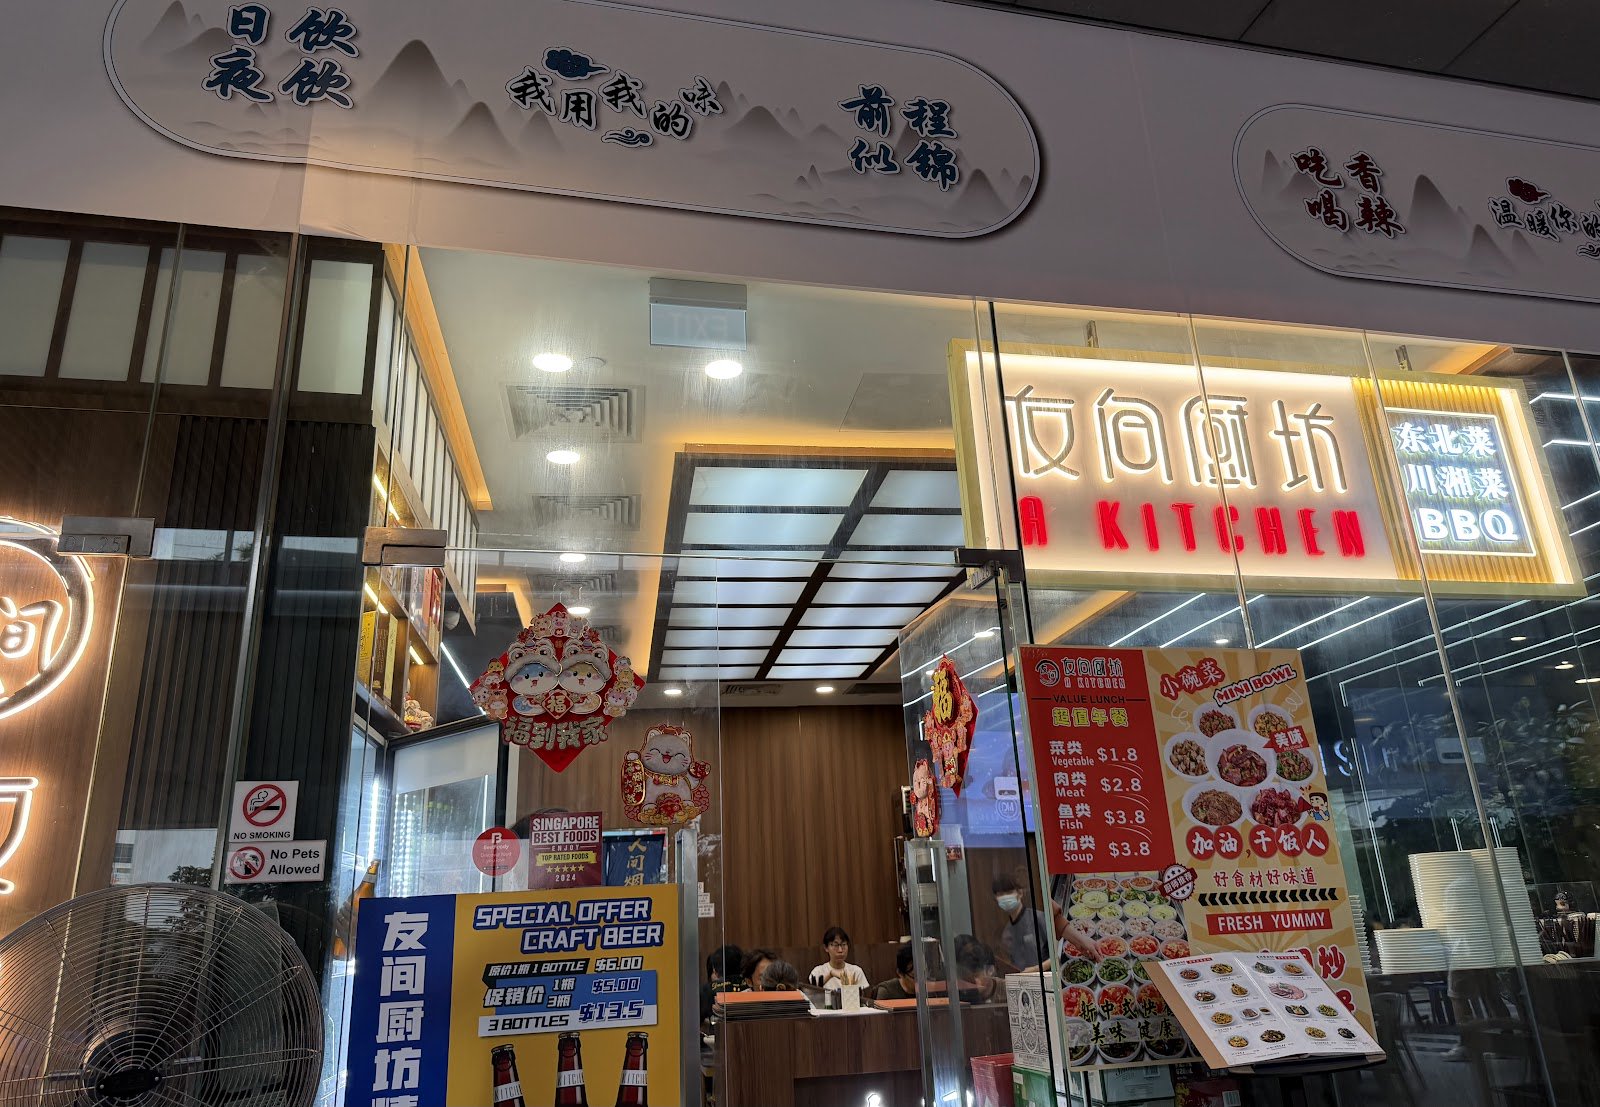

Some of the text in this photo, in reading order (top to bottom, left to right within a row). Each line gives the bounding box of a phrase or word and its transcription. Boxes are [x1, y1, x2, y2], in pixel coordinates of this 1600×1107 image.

[507, 68, 721, 139] 我用我的味
[1490, 198, 1600, 240] 温暖你的
[1394, 421, 1496, 457] 东北菜
[1404, 463, 1509, 500] 川湘菜
[1018, 495, 1367, 558] A KITCHEN
[1415, 507, 1519, 542] BBQ
[1077, 677, 1126, 689] KITCHEN
[1161, 660, 1224, 698] 小碗菜
[1214, 664, 1296, 706] MINI BOWL
[1052, 694, 1126, 704] VALUE LUNCH
[1052, 707, 1129, 727] 超值午餐
[1274, 728, 1304, 748] 美味
[1049, 740, 1138, 763] 菜类 $1.8
[1051, 756, 1095, 769] Vegetable
[1053, 771, 1142, 793] 肉类 $2.8
[1055, 787, 1086, 798] Meat
[532, 815, 599, 831] SINGAPORE
[1057, 802, 1146, 826] 鱼类 $3.8
[1059, 819, 1084, 830] Fish
[233, 831, 291, 840] NO SMOKING
[533, 829, 597, 844] BEST FOODS
[270, 847, 320, 860] No Pets
[1062, 834, 1151, 858] 汤类 $3.8
[542, 854, 552, 862] TOP
[553, 853, 570, 861] RATED
[1063, 851, 1094, 864] Soup
[268, 863, 320, 876] Allowed
[555, 874, 577, 882] 2024
[1213, 866, 1317, 888] 好食材好味道
[475, 898, 651, 928] SPECIAL OFFER
[1217, 912, 1326, 932] FRESH YUMMY
[523, 924, 663, 951] CRAFT BEER
[541, 960, 586, 974] BOTTLE
[594, 956, 643, 972] $6.00
[553, 976, 642, 994] 1瓶 $5.00
[483, 985, 546, 1007] 促销价
[547, 994, 572, 1008] 3瓶
[371, 911, 429, 1107] 友间厨坊
[488, 1000, 645, 1031] 3 BOTTLES $13.5
